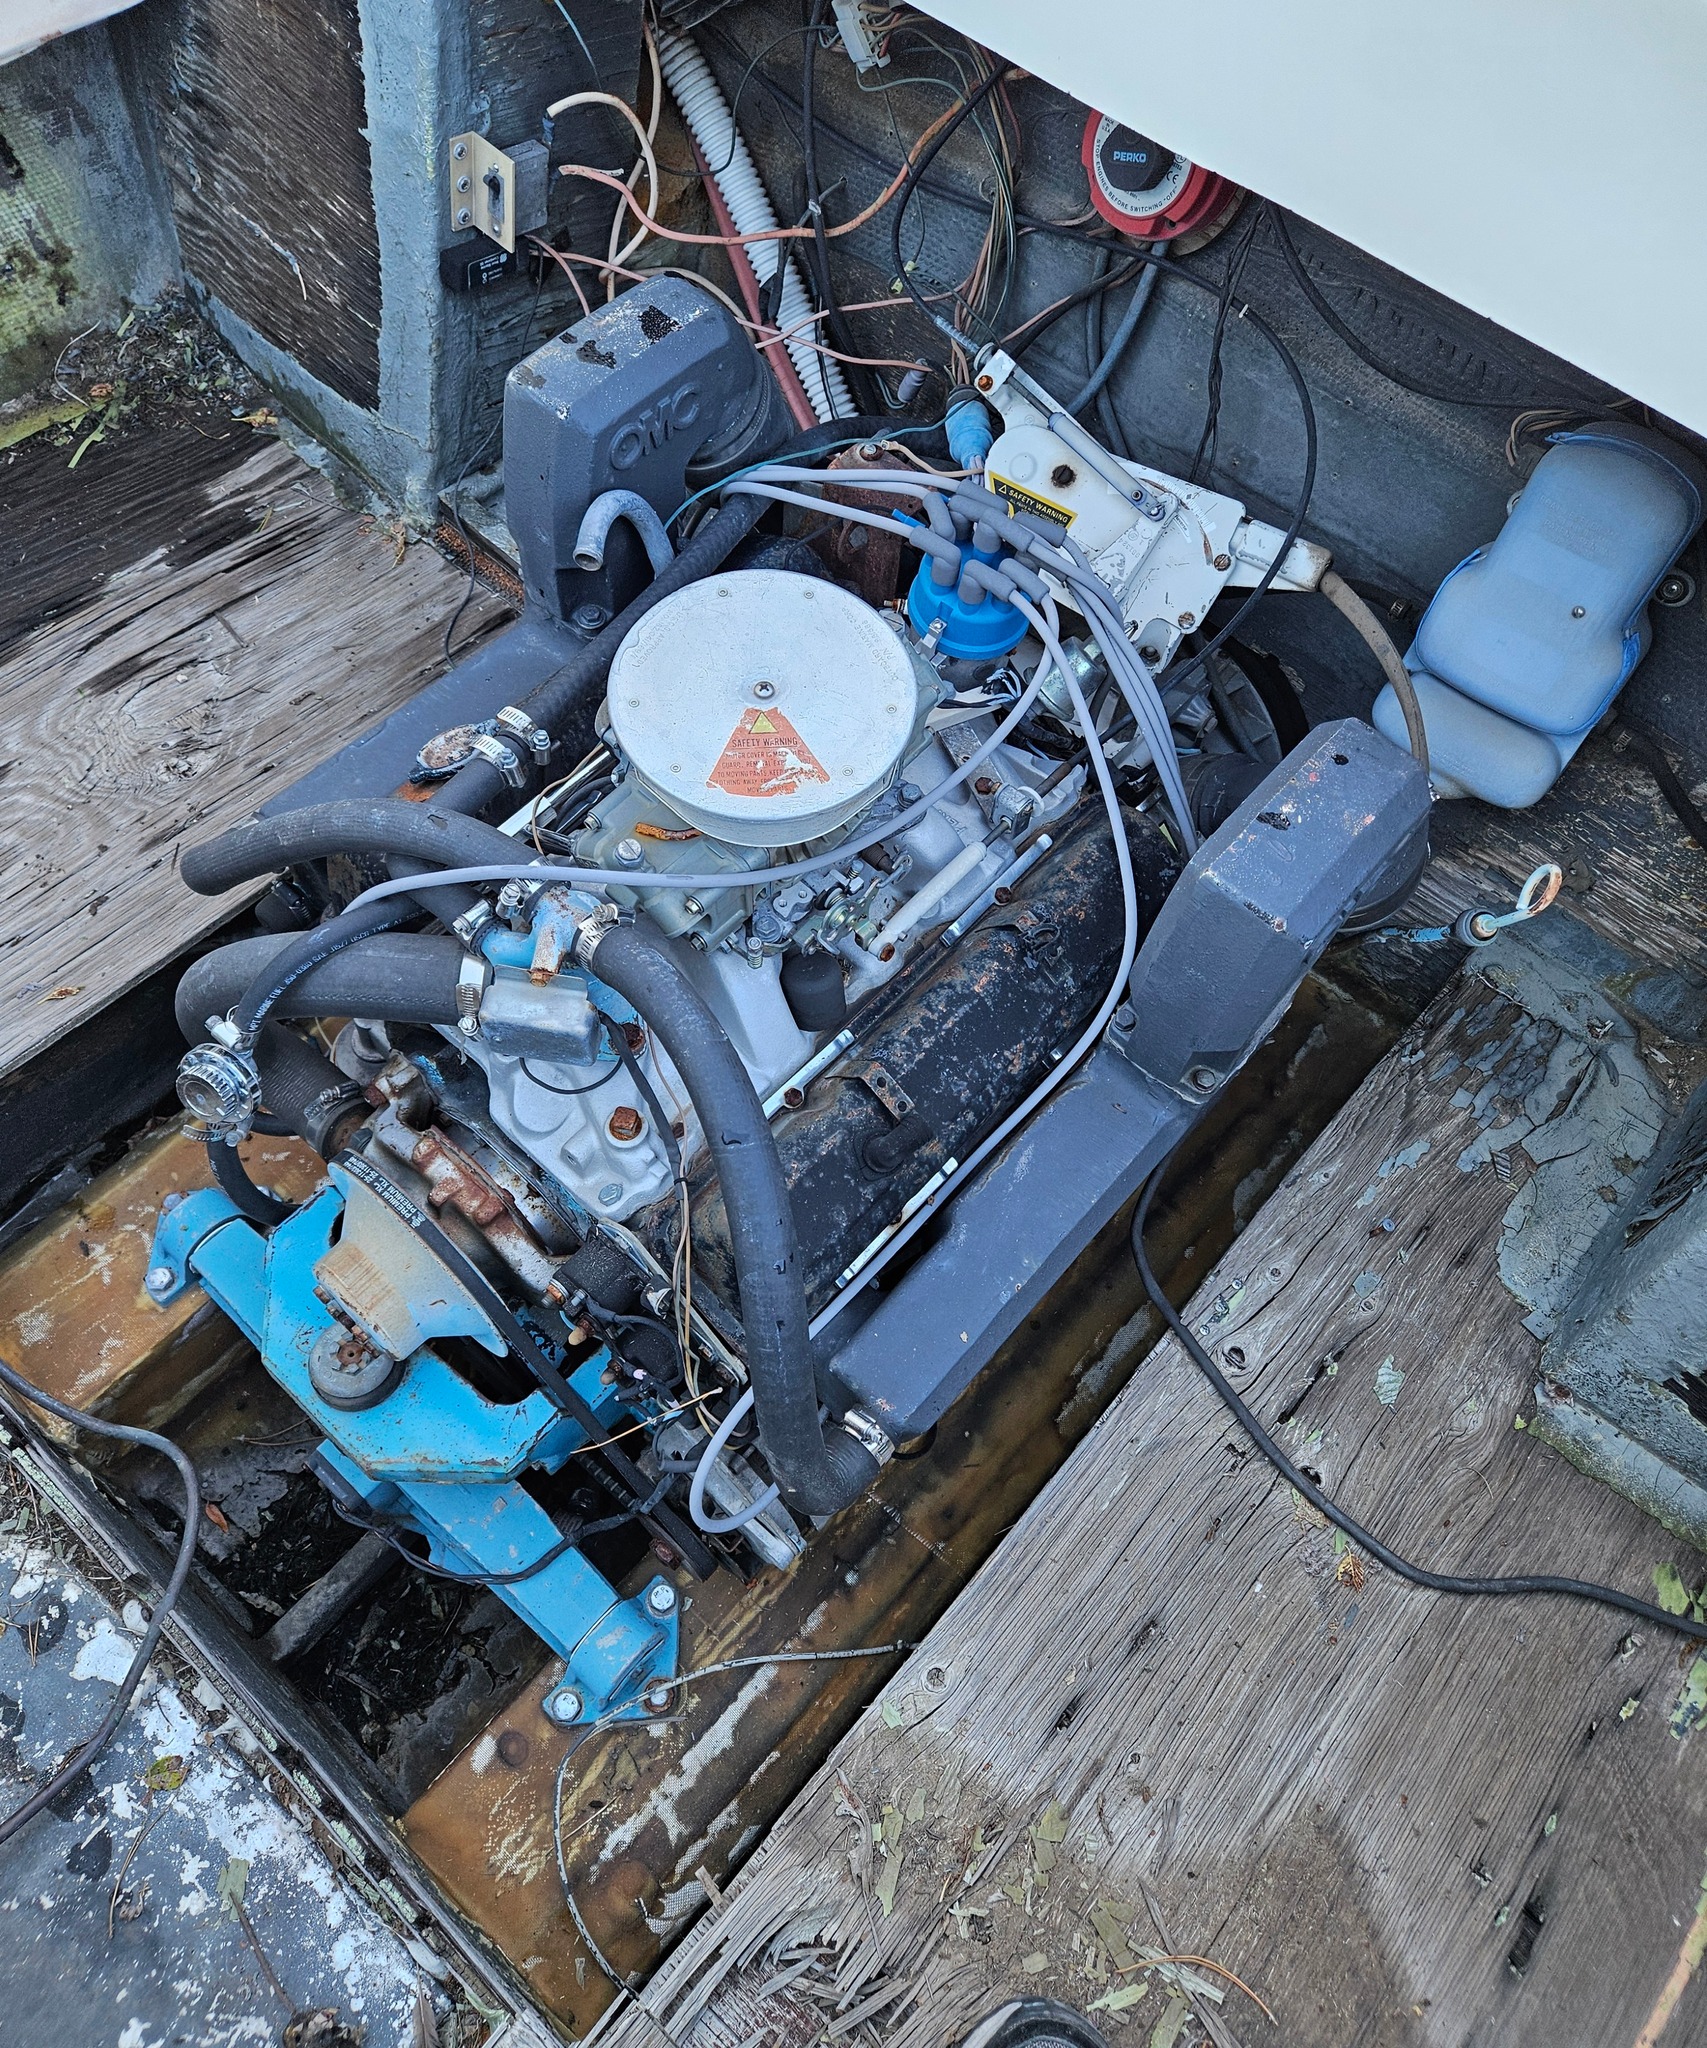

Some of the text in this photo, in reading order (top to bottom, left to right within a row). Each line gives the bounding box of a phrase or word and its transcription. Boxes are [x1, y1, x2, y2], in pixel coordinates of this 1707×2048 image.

[1113, 150, 1147, 163] PERKO
[1096, 161, 1110, 191] ENGINES
[1108, 191, 1129, 210] BEFORE
[1130, 201, 1163, 213] SWITCHING
[607, 382, 701, 471] OMC
[1008, 489, 1034, 506] SAFETY
[1035, 501, 1069, 523] WARNING
[732, 737, 798, 748] SAFETY WARNING
[746, 751, 765, 759] COVER
[746, 760, 771, 768] REMVAL
[726, 770, 749, 778] MOVING
[770, 769, 784, 777] KEEP
[254, 997, 276, 1019] MARINE
[269, 985, 287, 999] FUEL
[311, 951, 329, 963] SAE
[372, 922, 391, 934] TYPE
[378, 1176, 390, 1188] XL
[382, 1191, 412, 1219] PREMIUM
[387, 1185, 418, 1214] PREMIUM
